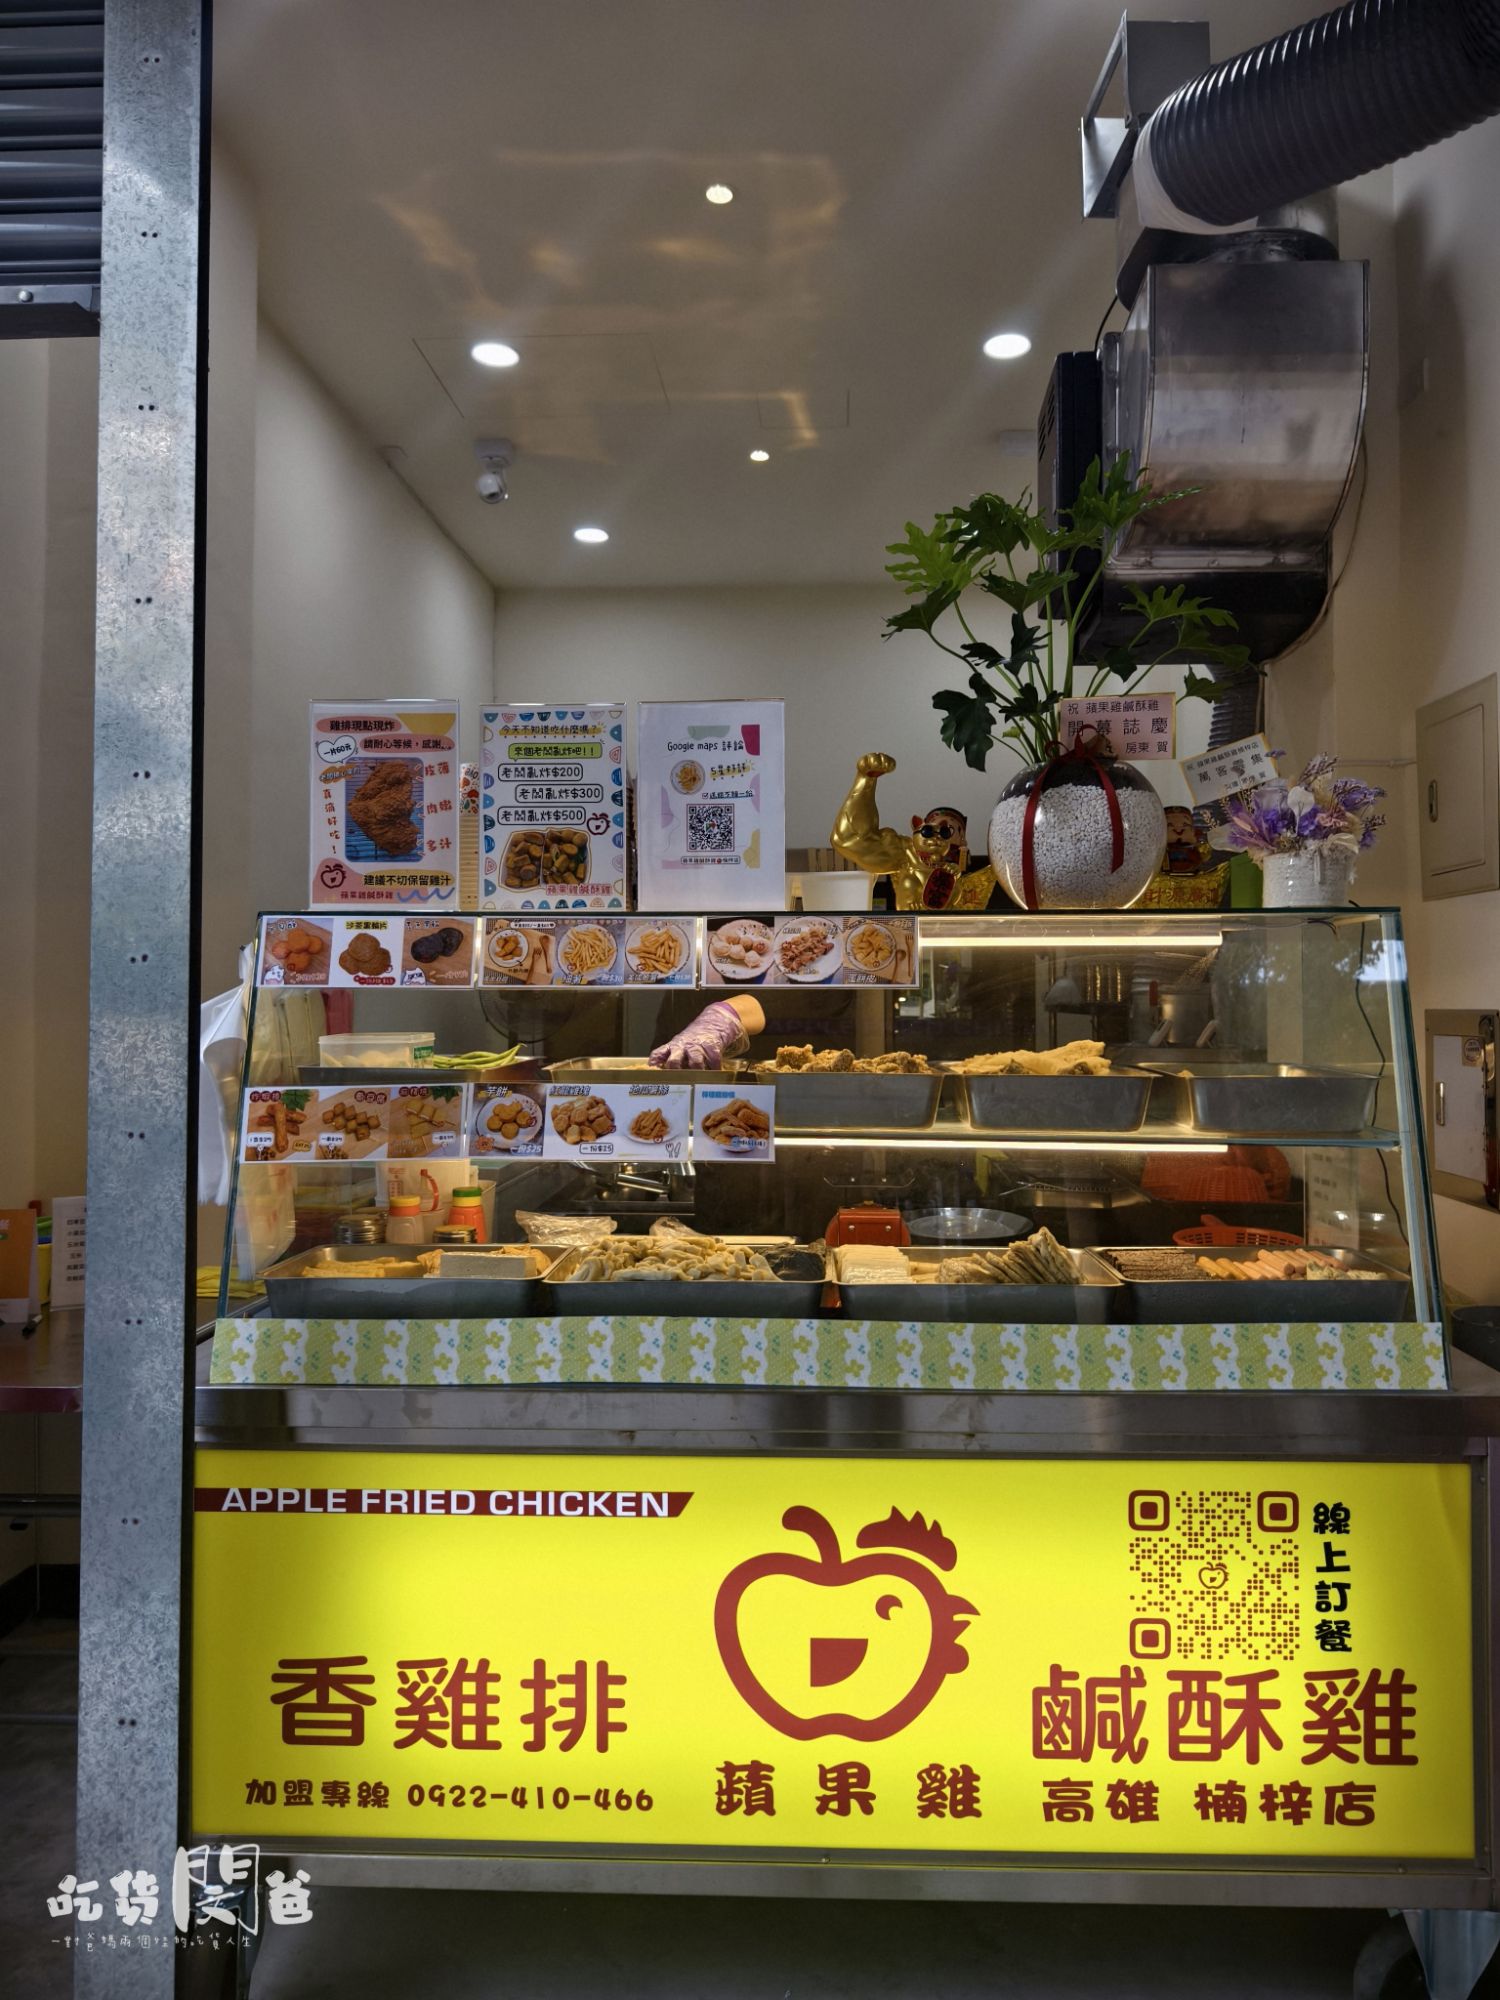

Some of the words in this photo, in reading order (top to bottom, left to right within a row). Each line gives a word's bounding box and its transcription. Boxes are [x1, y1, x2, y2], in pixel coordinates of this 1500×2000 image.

[1067, 702, 1079, 715] 祝
[1085, 699, 1160, 714] 蘋果雞鹹酥雞
[330, 719, 395, 731] 雞排現點現炸
[667, 741, 694, 752] Google
[697, 742, 718, 752] maps
[1126, 741, 1149, 754] 房東
[1156, 741, 1168, 753] 賀
[364, 874, 451, 886] 建議不切保留雞汁
[221, 1487, 347, 1513] APPLE
[361, 1489, 476, 1515] FRIED
[488, 1490, 670, 1517] CHICKEN
[1312, 1502, 1353, 1653] 線上訂餐
[270, 1655, 628, 1754] 香雞排
[1032, 1663, 1419, 1766] 鹹酥雞
[245, 1778, 390, 1810] 加盟專線
[407, 1783, 654, 1811] 0922-410-466
[715, 1760, 983, 1819] 蘋果雞
[1042, 1777, 1161, 1824] 高雄
[1193, 1779, 1377, 1827] 楠梓店
